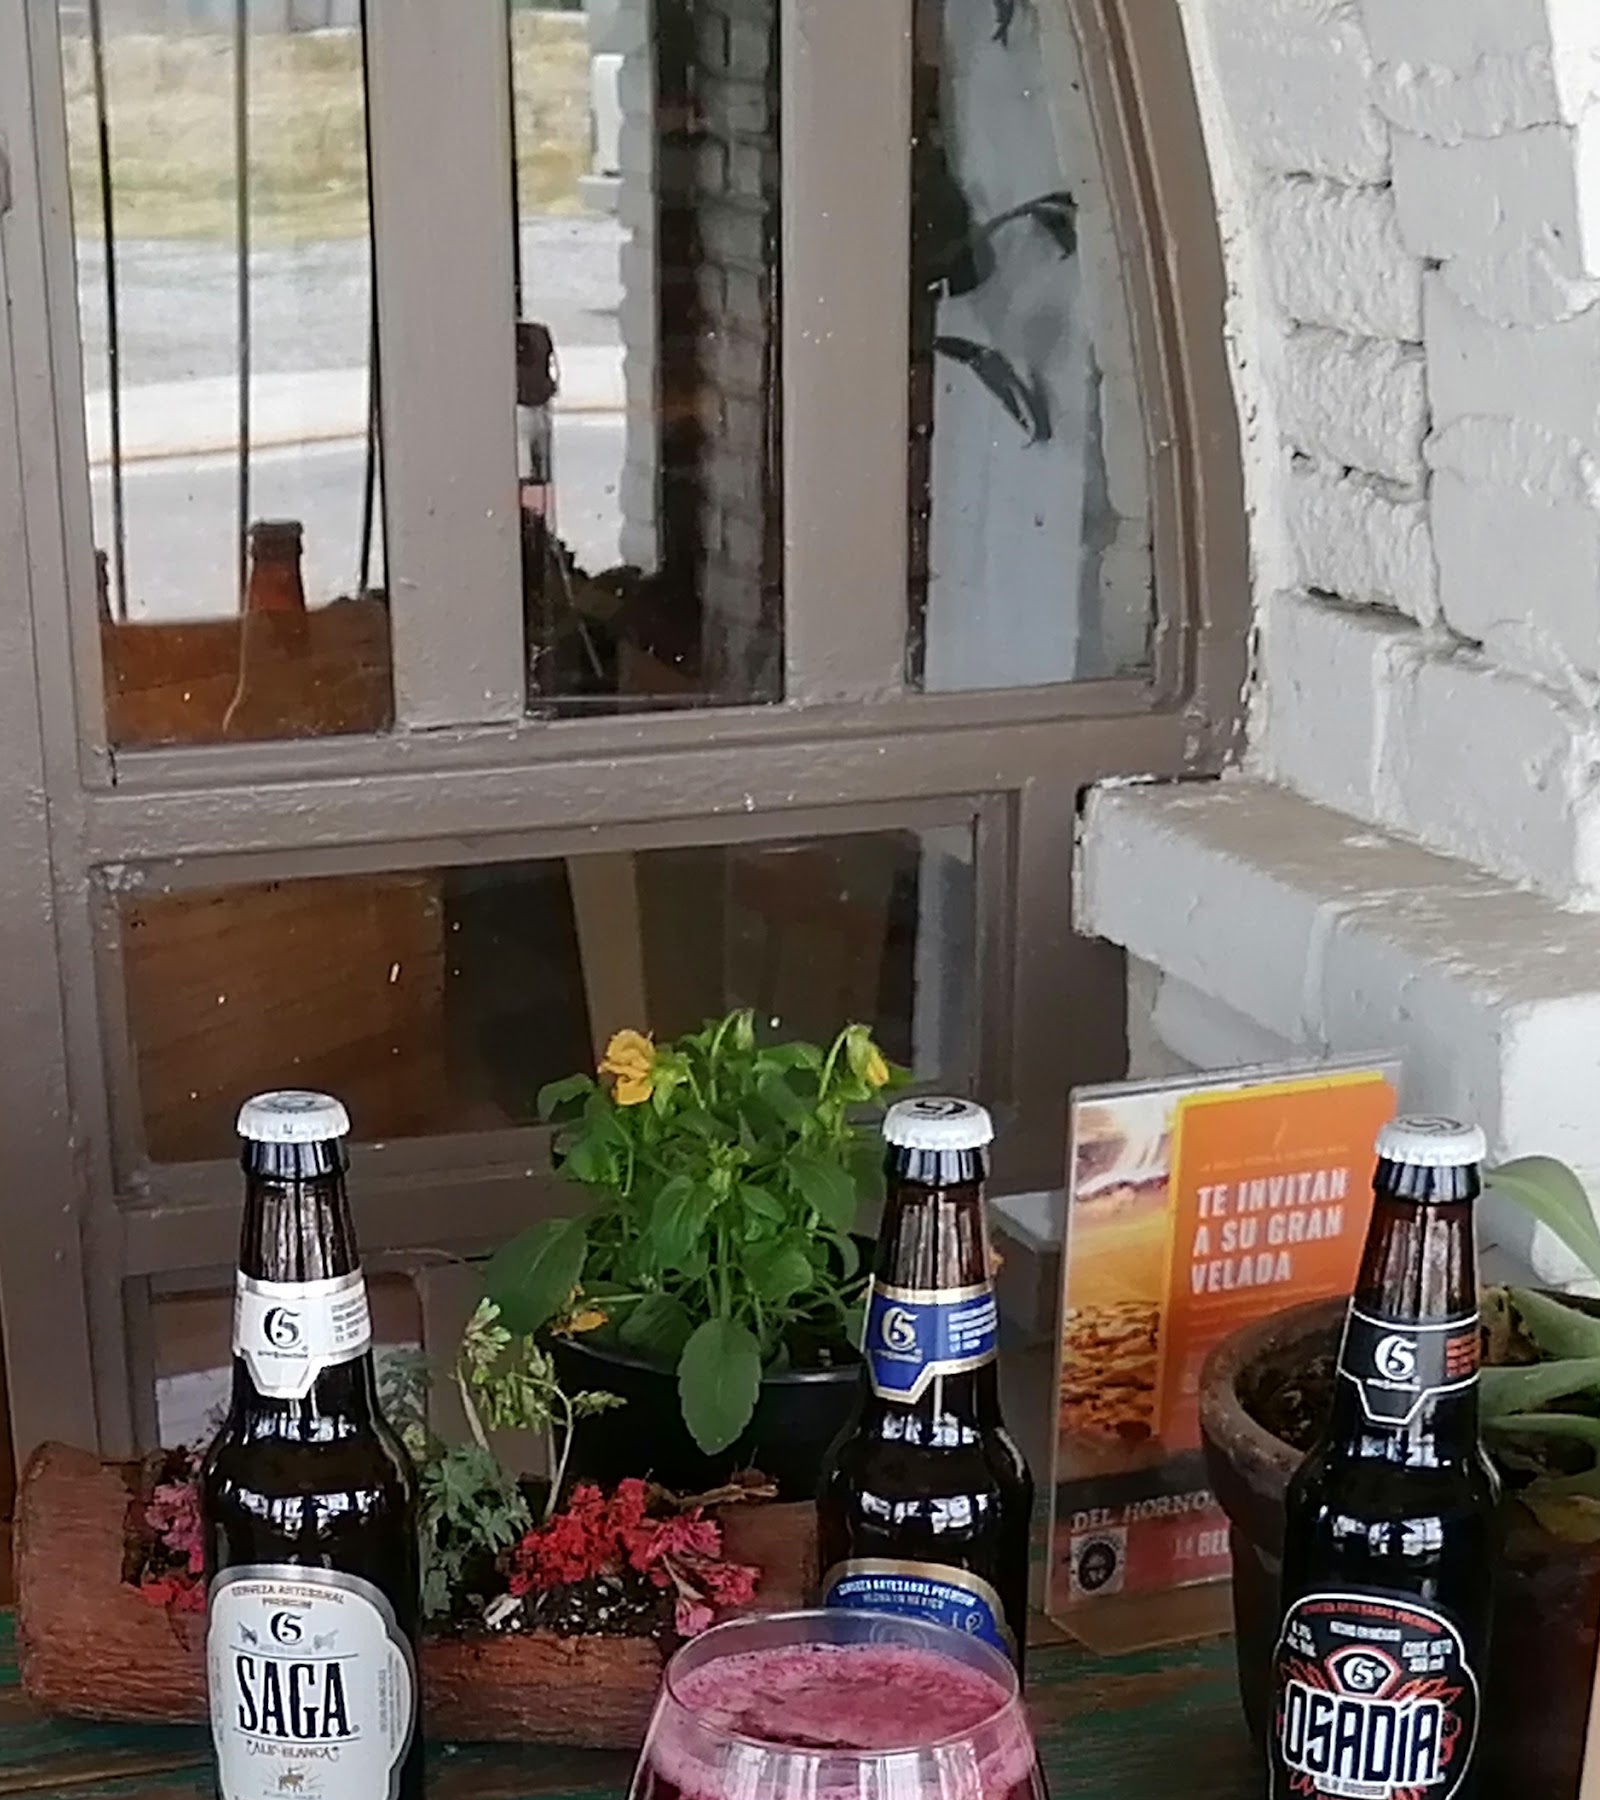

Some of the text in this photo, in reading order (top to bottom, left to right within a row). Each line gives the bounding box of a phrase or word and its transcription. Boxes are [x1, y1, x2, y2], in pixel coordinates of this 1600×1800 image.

[1197, 1168, 1349, 1219] TE INVITAN
[1193, 1205, 1344, 1257] A SU GRAN
[1191, 1251, 1292, 1295] VELADA
[236, 1655, 353, 1739] SAGA
